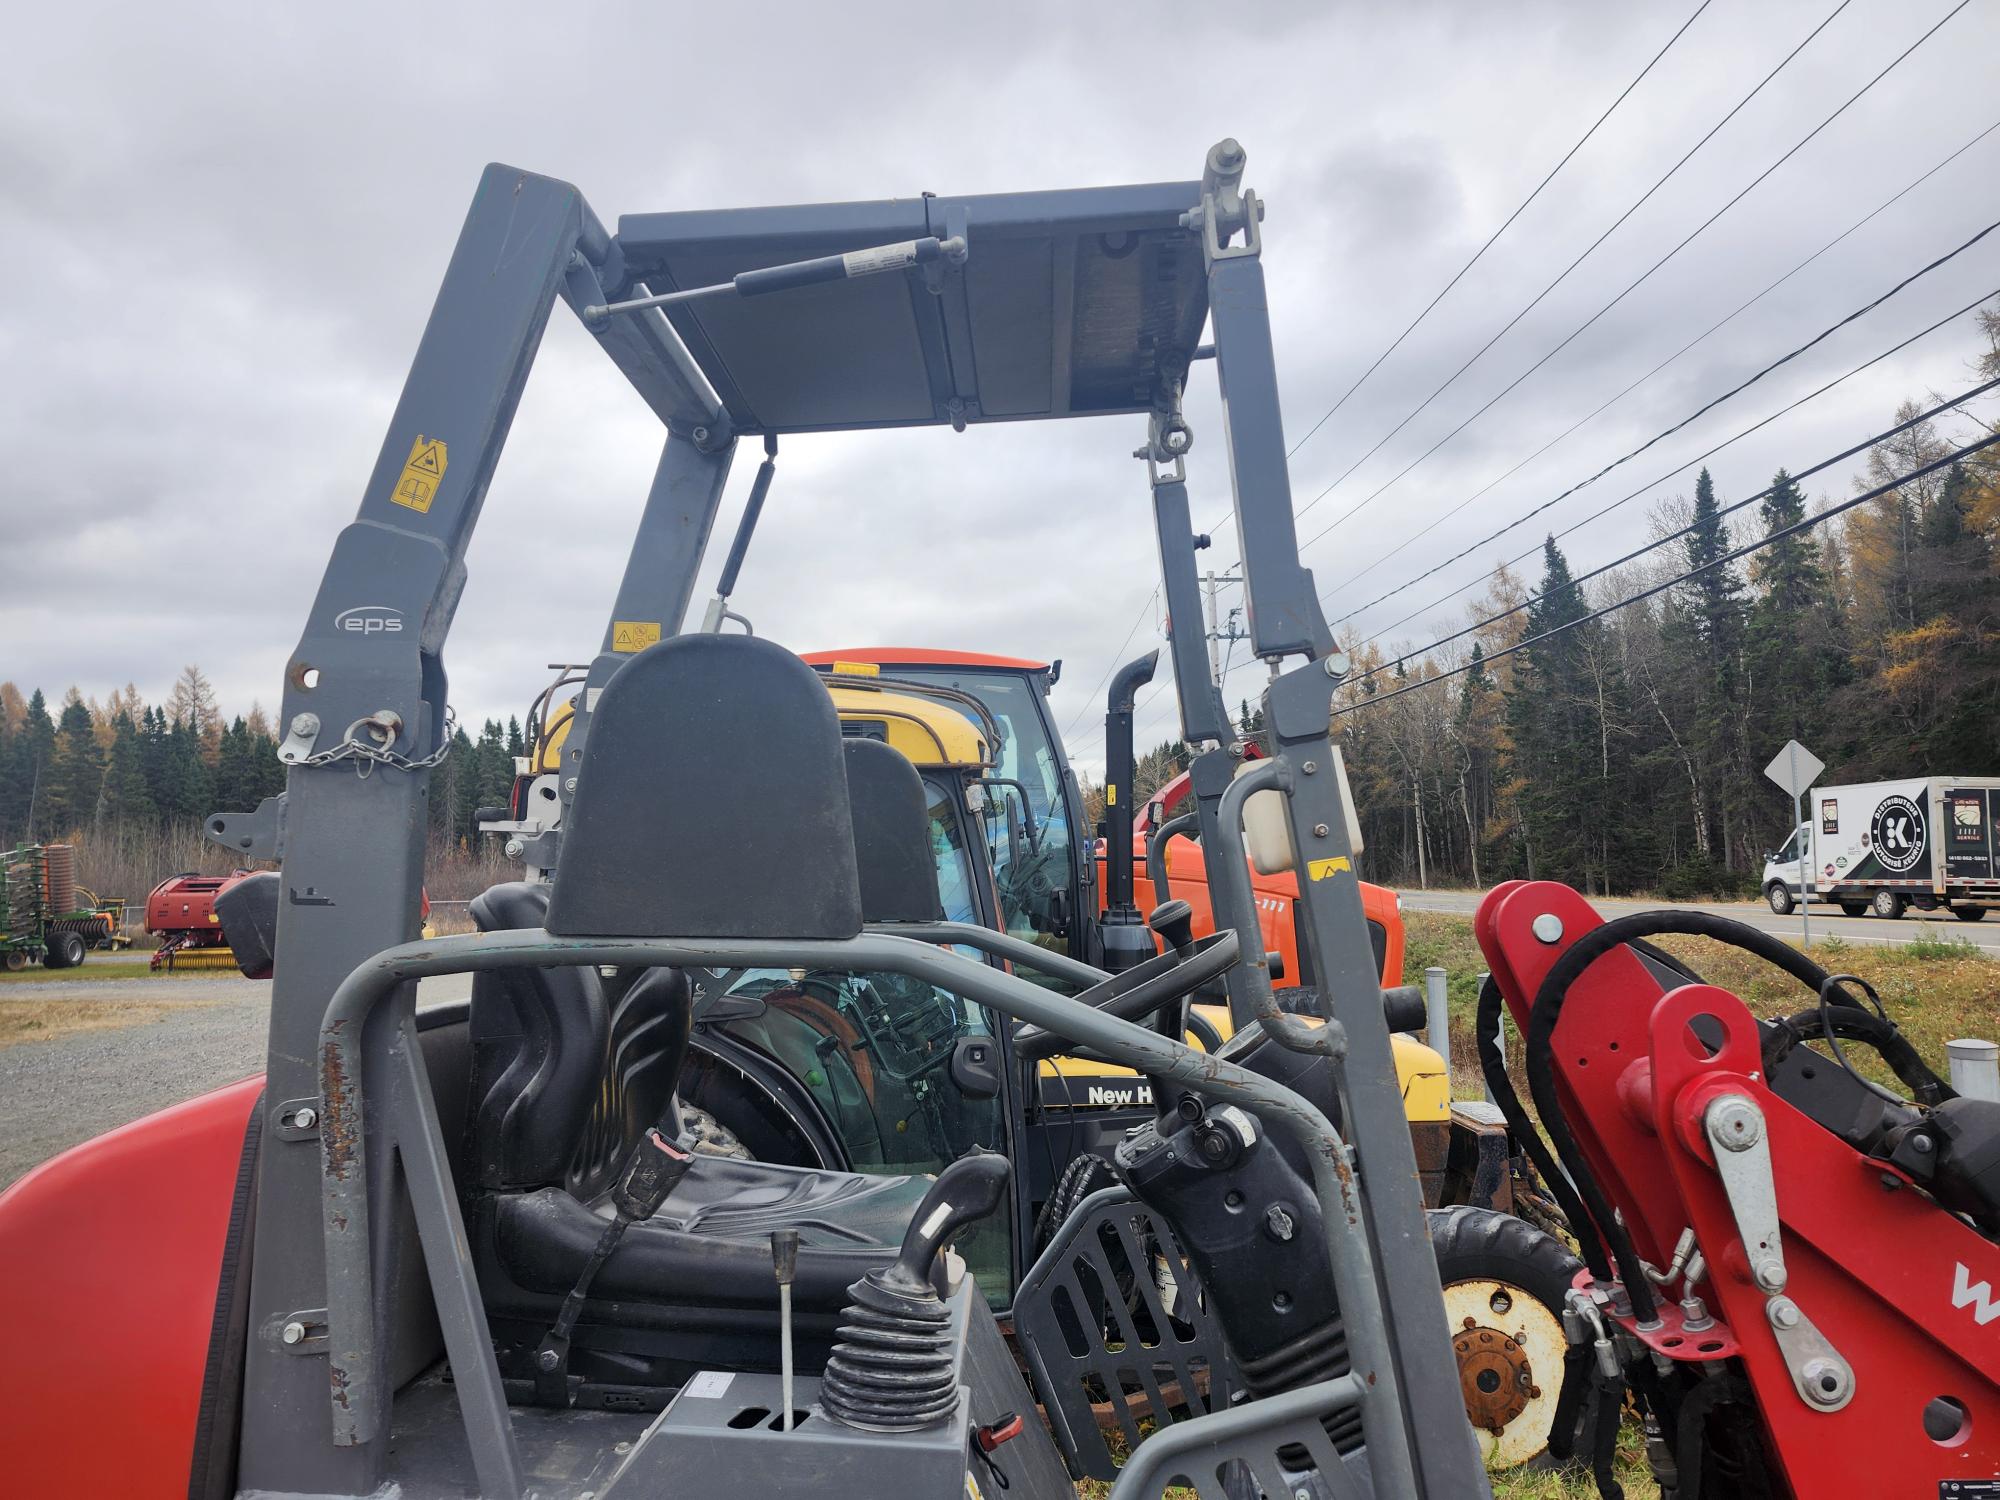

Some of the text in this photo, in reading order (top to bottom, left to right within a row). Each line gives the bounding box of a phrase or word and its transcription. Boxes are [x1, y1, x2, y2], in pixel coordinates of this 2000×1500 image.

[344, 618, 403, 635] eps
[1874, 797, 1919, 820] DISTRIBUTEUR
[1902, 840, 1922, 866] KEURIG
[1254, 894, 1285, 912] -111
[1088, 1086, 1153, 1104] New H
